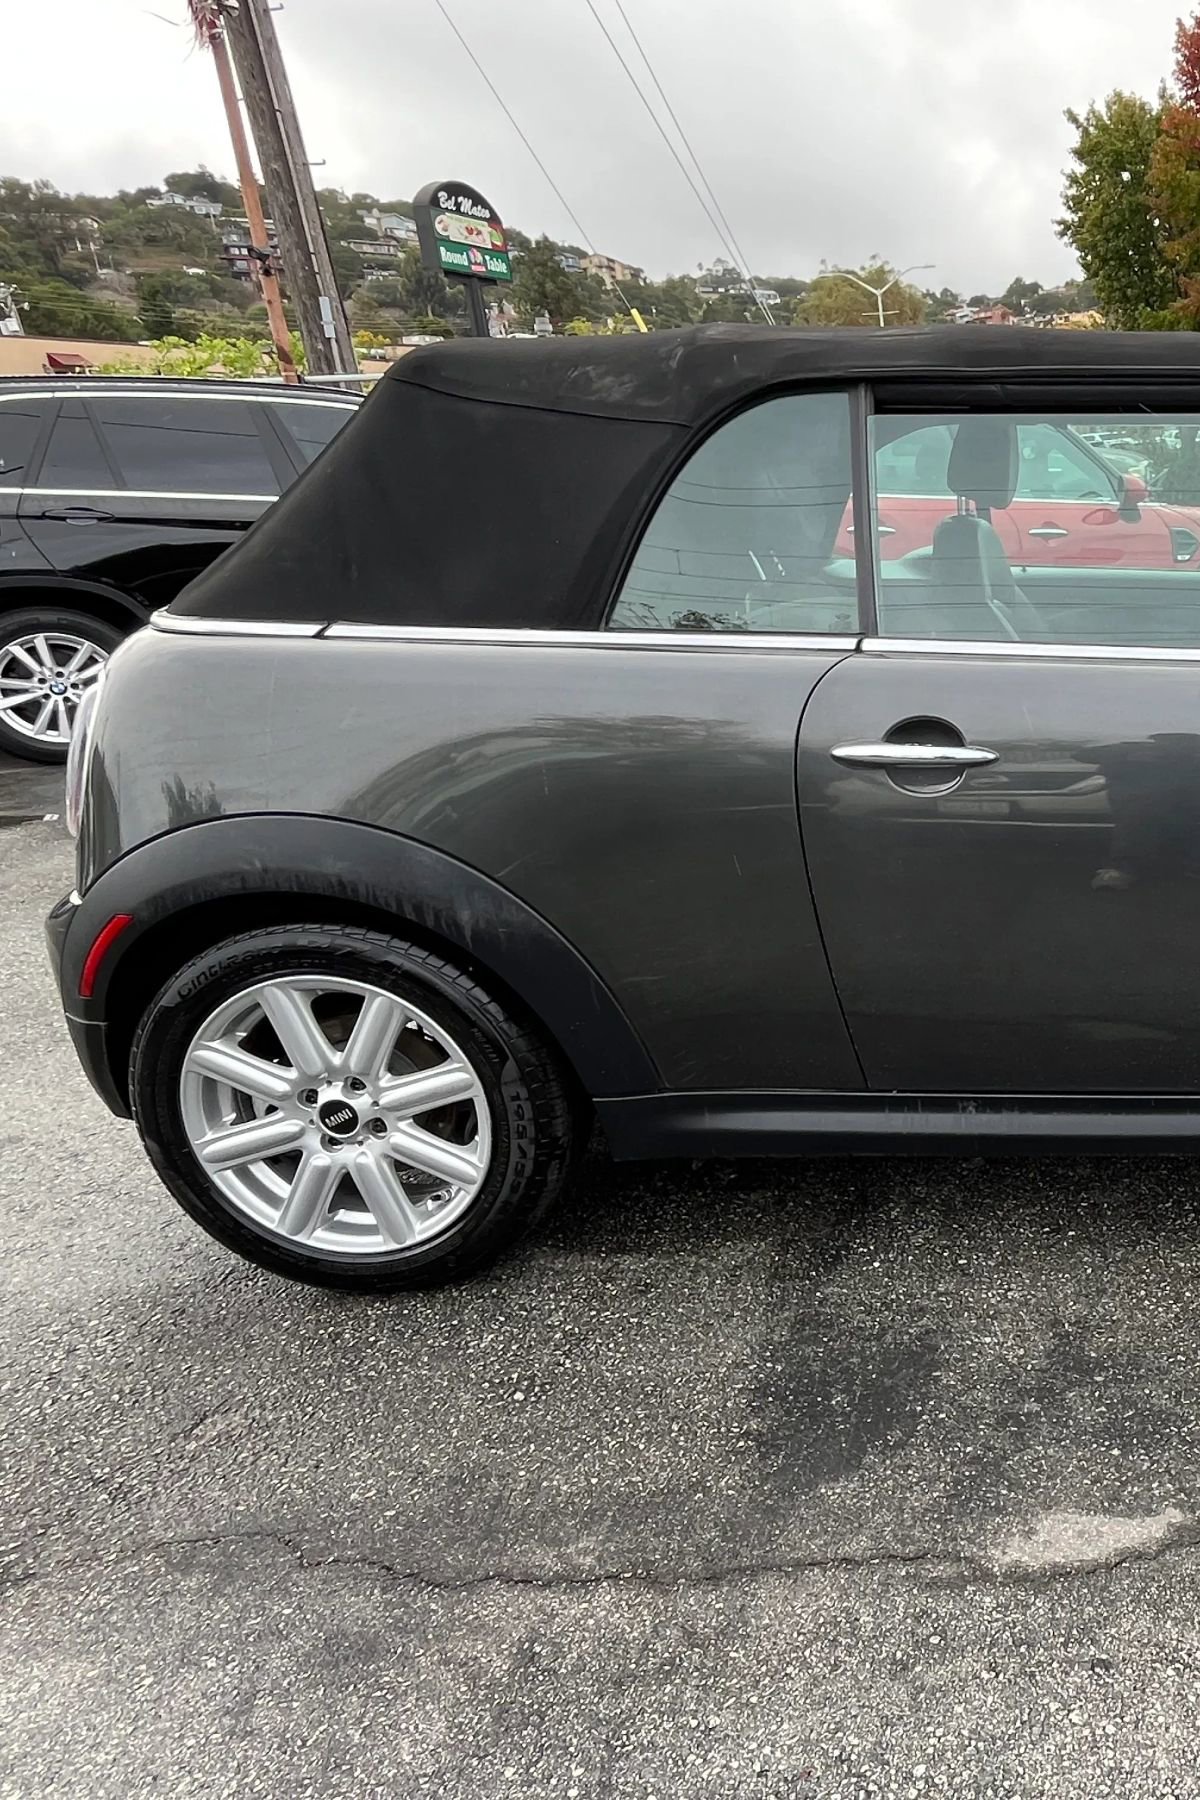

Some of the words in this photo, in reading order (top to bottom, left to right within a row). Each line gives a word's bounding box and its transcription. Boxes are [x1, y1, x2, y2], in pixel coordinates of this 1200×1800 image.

[438, 191, 456, 210] Bel
[458, 196, 490, 218] Mateo
[440, 246, 469, 266] Round
[484, 255, 508, 273] Table
[325, 1108, 353, 1127] MINI
